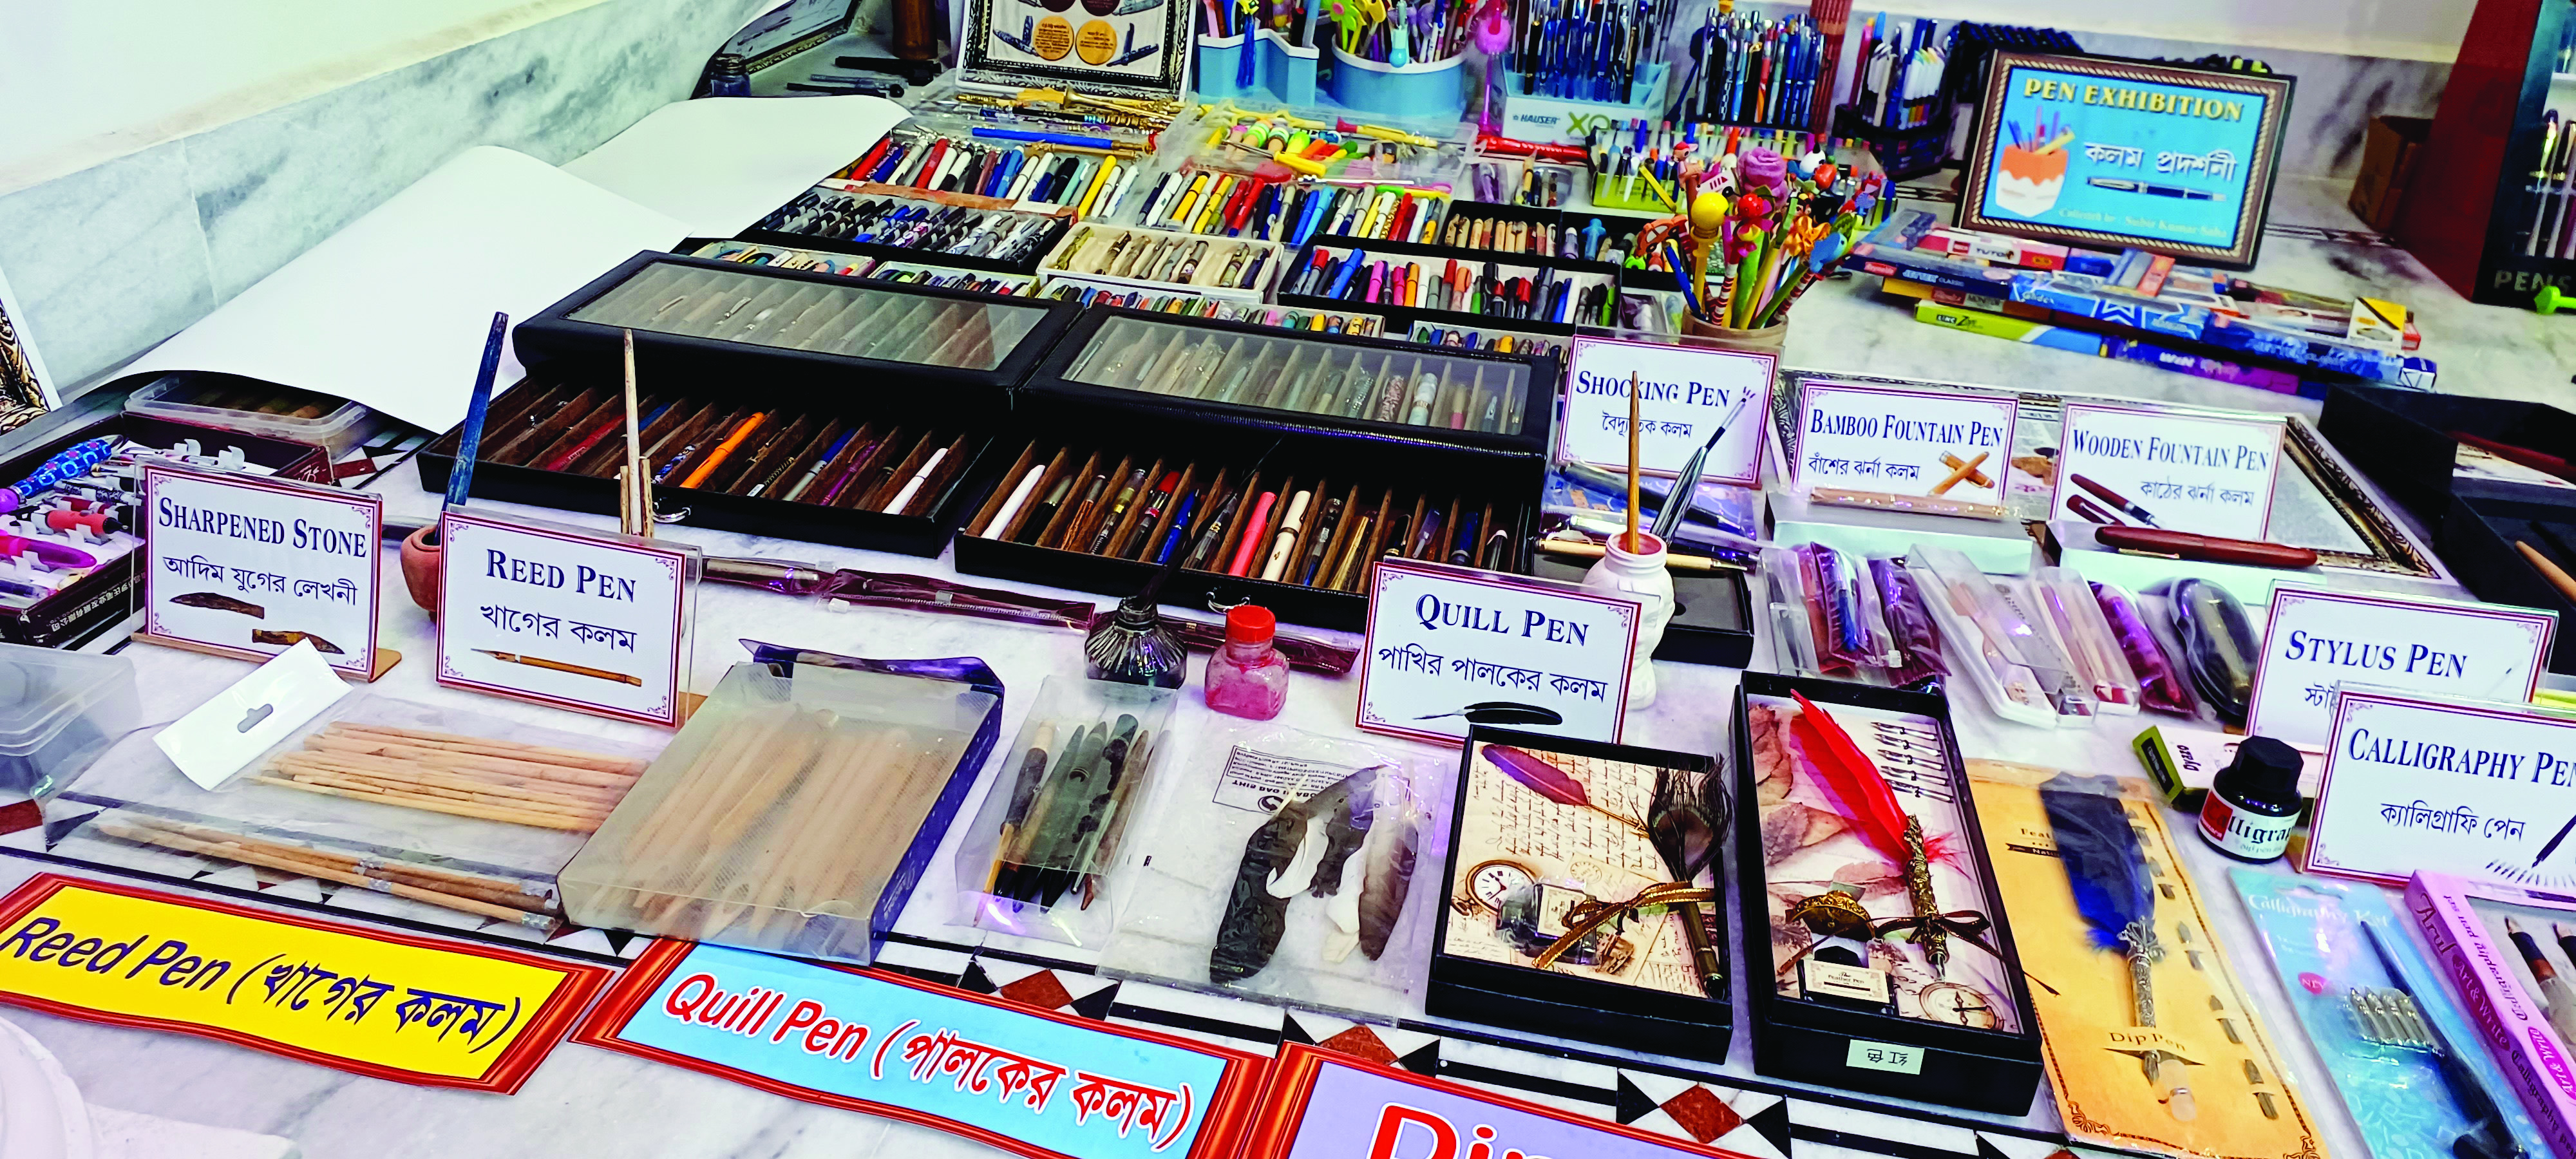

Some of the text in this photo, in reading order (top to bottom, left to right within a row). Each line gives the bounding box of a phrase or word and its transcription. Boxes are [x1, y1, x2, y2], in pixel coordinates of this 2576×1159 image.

[1520, 114, 1558, 125] HAUSER
[2023, 77, 2244, 122] PEN EXHIBITION
[2083, 141, 2238, 182] কলম প্রদর্শনী
[1576, 371, 1730, 407] SHOCKING PEN
[1661, 422, 1692, 438] কলম
[1811, 409, 2003, 448] BAMBOO FOUNTAIN PEN
[2073, 429, 2269, 473] WOODEN FOUNTAIN PEN
[1808, 452, 1920, 480] বাঁশের ঝর্না কলম
[2141, 476, 2183, 501] কাঠের
[2220, 487, 2255, 507] কলম
[158, 498, 366, 558] SHARPENED STONE
[162, 555, 357, 607] আদিম যুগের লেখনী
[486, 549, 636, 602] REED PEN
[480, 604, 637, 653] খাগের কলম
[1416, 594, 1589, 646] QUILL PEN
[1379, 643, 1608, 703] পাখির পালকের কলম
[2286, 630, 2468, 679] STYLUS PEN
[2349, 728, 2525, 781] CALLIGRAPHY
[2380, 800, 2526, 842] ক্যালিগ্রাফি পেন
[2458, 916, 2479, 938] pen
[0, 917, 520, 1053] Reed Pen (খাগের কলম)
[2454, 961, 2472, 988] Art
[2479, 996, 2507, 1046] Write
[2474, 939, 2528, 1021] Calligraphy
[665, 973, 1193, 1150] Quill Pen (পালকের কলম)
[1867, 1049, 1908, 1066] 红色
[2109, 1032, 2186, 1051] Dip Pen
[2512, 1050, 2559, 1133] Calligraphy
[1366, 1102, 1553, 1159] Di
